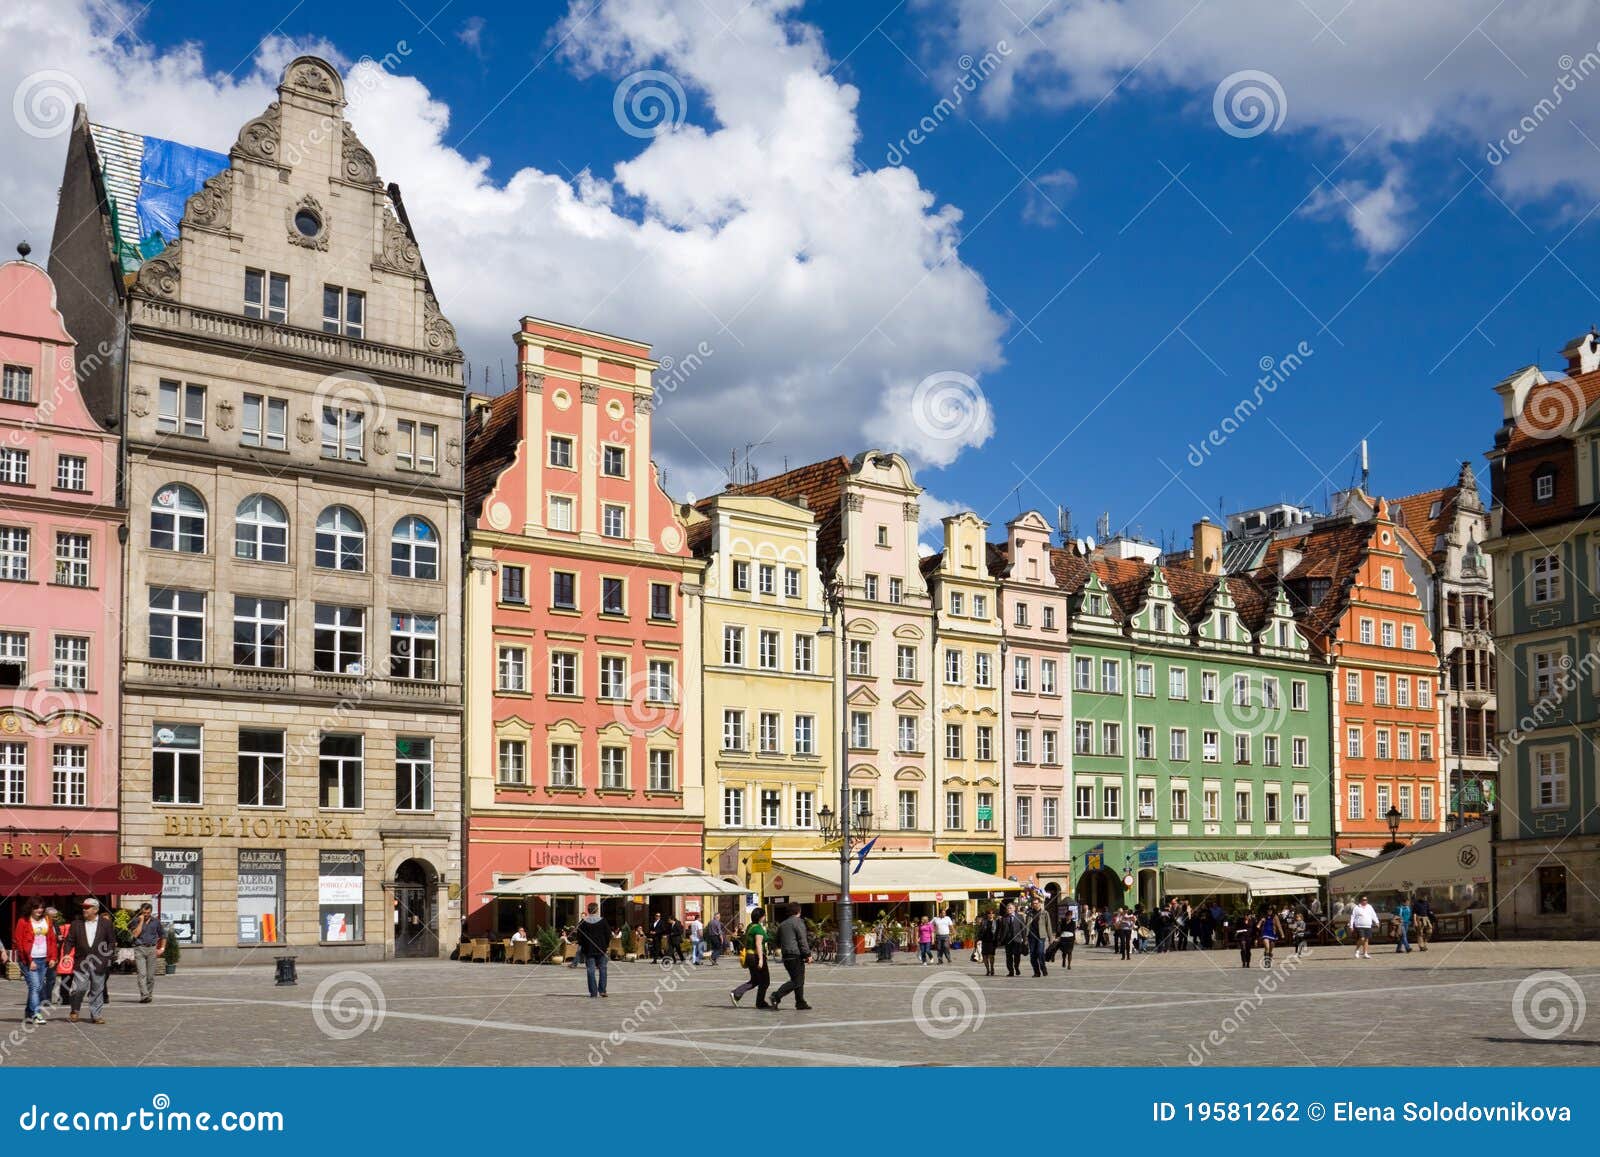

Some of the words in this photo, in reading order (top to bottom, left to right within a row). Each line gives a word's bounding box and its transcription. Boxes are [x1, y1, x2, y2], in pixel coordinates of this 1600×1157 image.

[164, 815, 353, 840] BIBLIOTEKA
[2, 842, 81, 857] ERNIA
[185, 851, 199, 862] CD
[1234, 850, 1249, 861] BAR
[535, 851, 597, 866] Literatka
